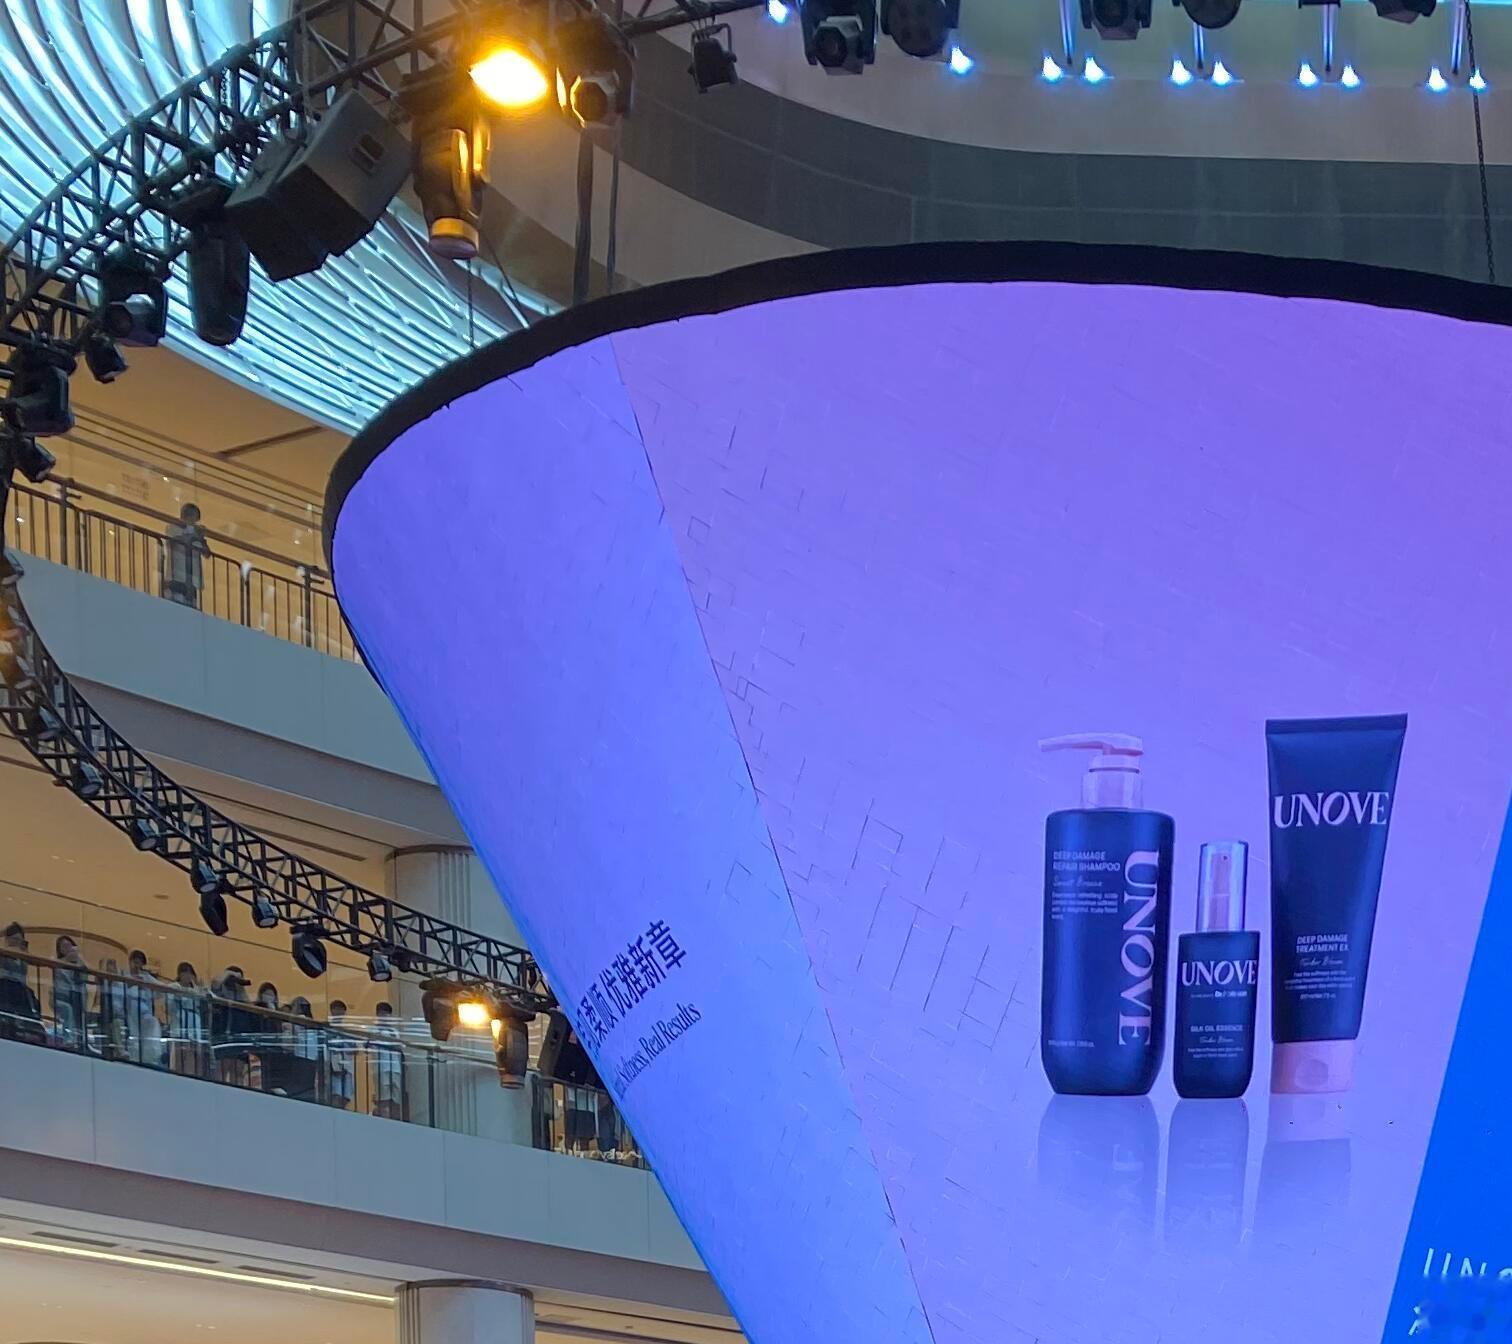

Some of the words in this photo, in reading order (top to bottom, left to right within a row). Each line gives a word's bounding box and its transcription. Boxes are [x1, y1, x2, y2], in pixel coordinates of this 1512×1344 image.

[1274, 790, 1390, 829] UNOVE
[1118, 849, 1160, 1046] UNOVE
[1181, 960, 1257, 987] UNOVE
